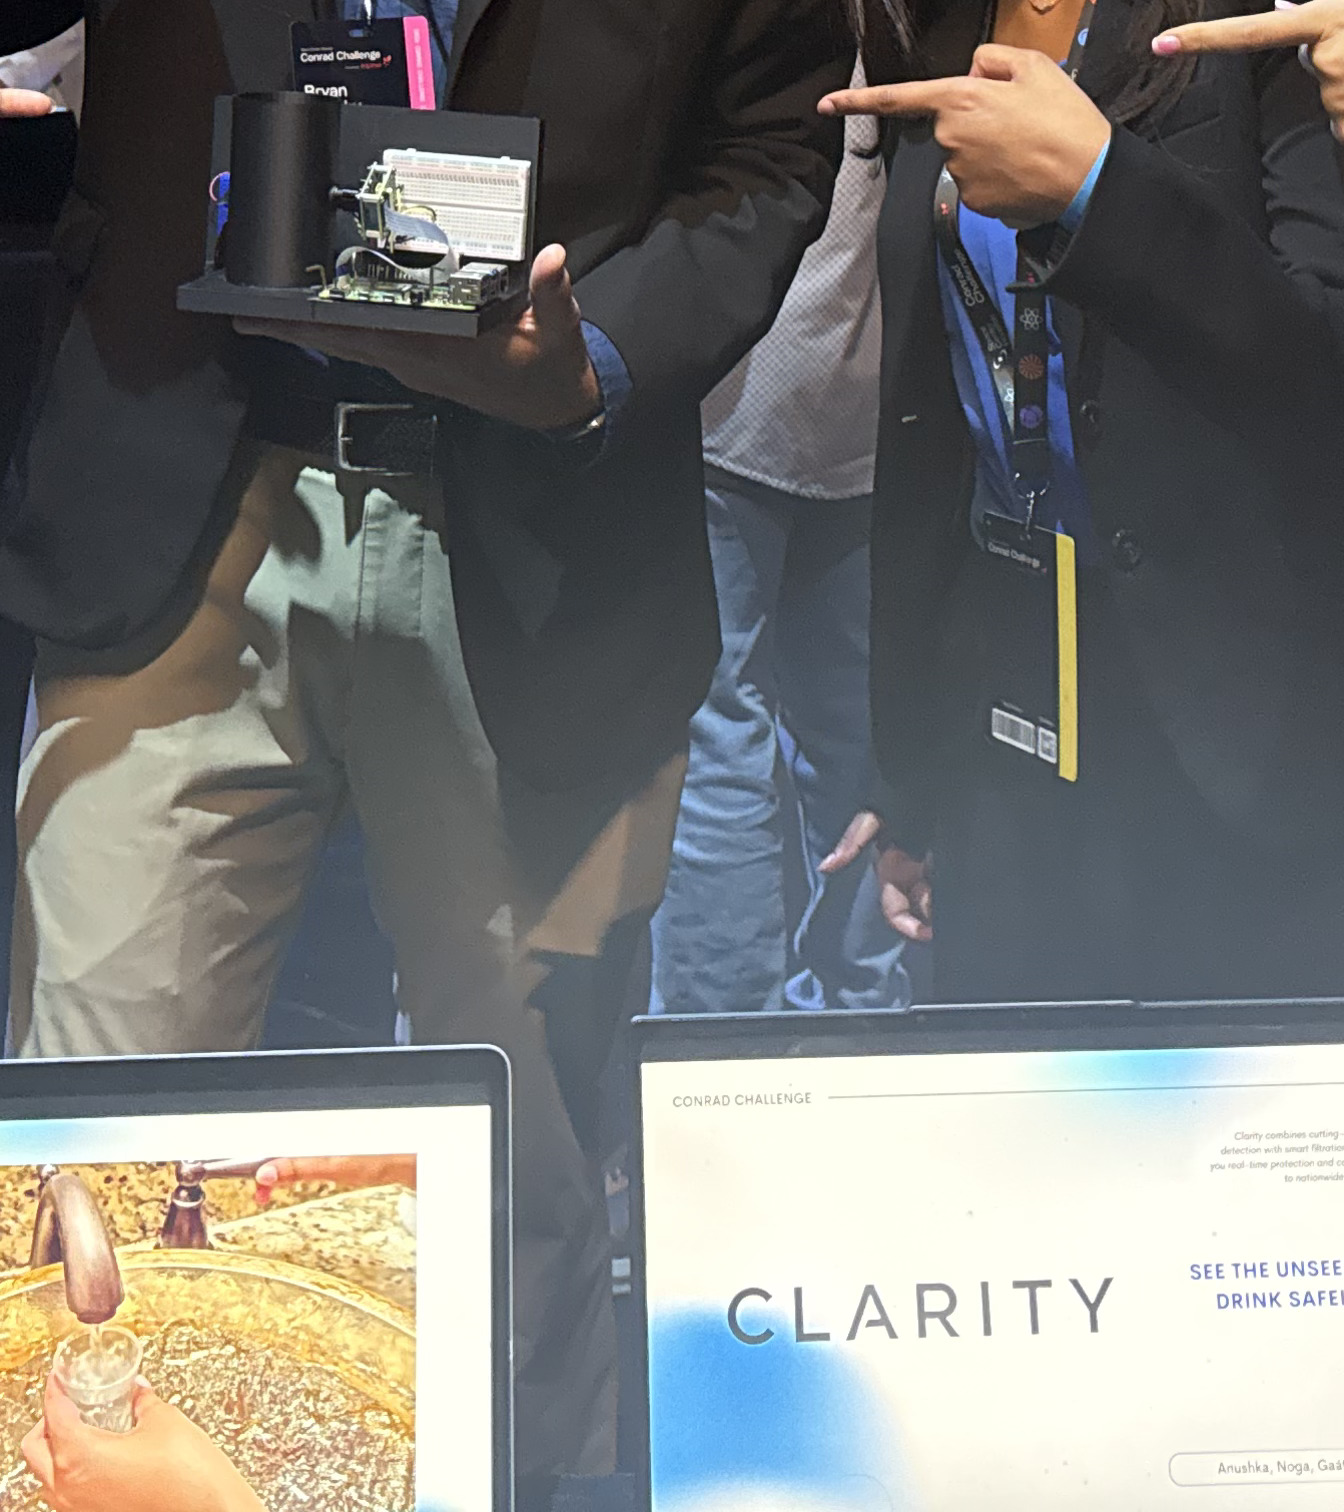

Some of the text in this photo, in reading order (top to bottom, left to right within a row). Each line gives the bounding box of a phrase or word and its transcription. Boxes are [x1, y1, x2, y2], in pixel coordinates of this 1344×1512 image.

[300, 50, 381, 63] Conrad Challenge
[672, 1092, 812, 1108] CONRAD CHALLENGE
[1234, 1131, 1263, 1142] Clarity
[1265, 1130, 1307, 1140] combines
[1220, 1145, 1262, 1155] detection
[1264, 1145, 1283, 1155] with
[1285, 1144, 1309, 1154] smart
[1210, 1162, 1226, 1172] you
[1270, 1158, 1315, 1171] protection
[1317, 1157, 1334, 1168] and
[1284, 1173, 1294, 1183] to
[1296, 1172, 1344, 1182] nationwide
[1190, 1263, 1225, 1281] SEE
[1231, 1261, 1269, 1279] THE
[1217, 1292, 1282, 1310] DRINK
[726, 1277, 1115, 1345] CLARITY
[1218, 1461, 1274, 1476] Anushka,
[1276, 1460, 1314, 1477] Noga,
